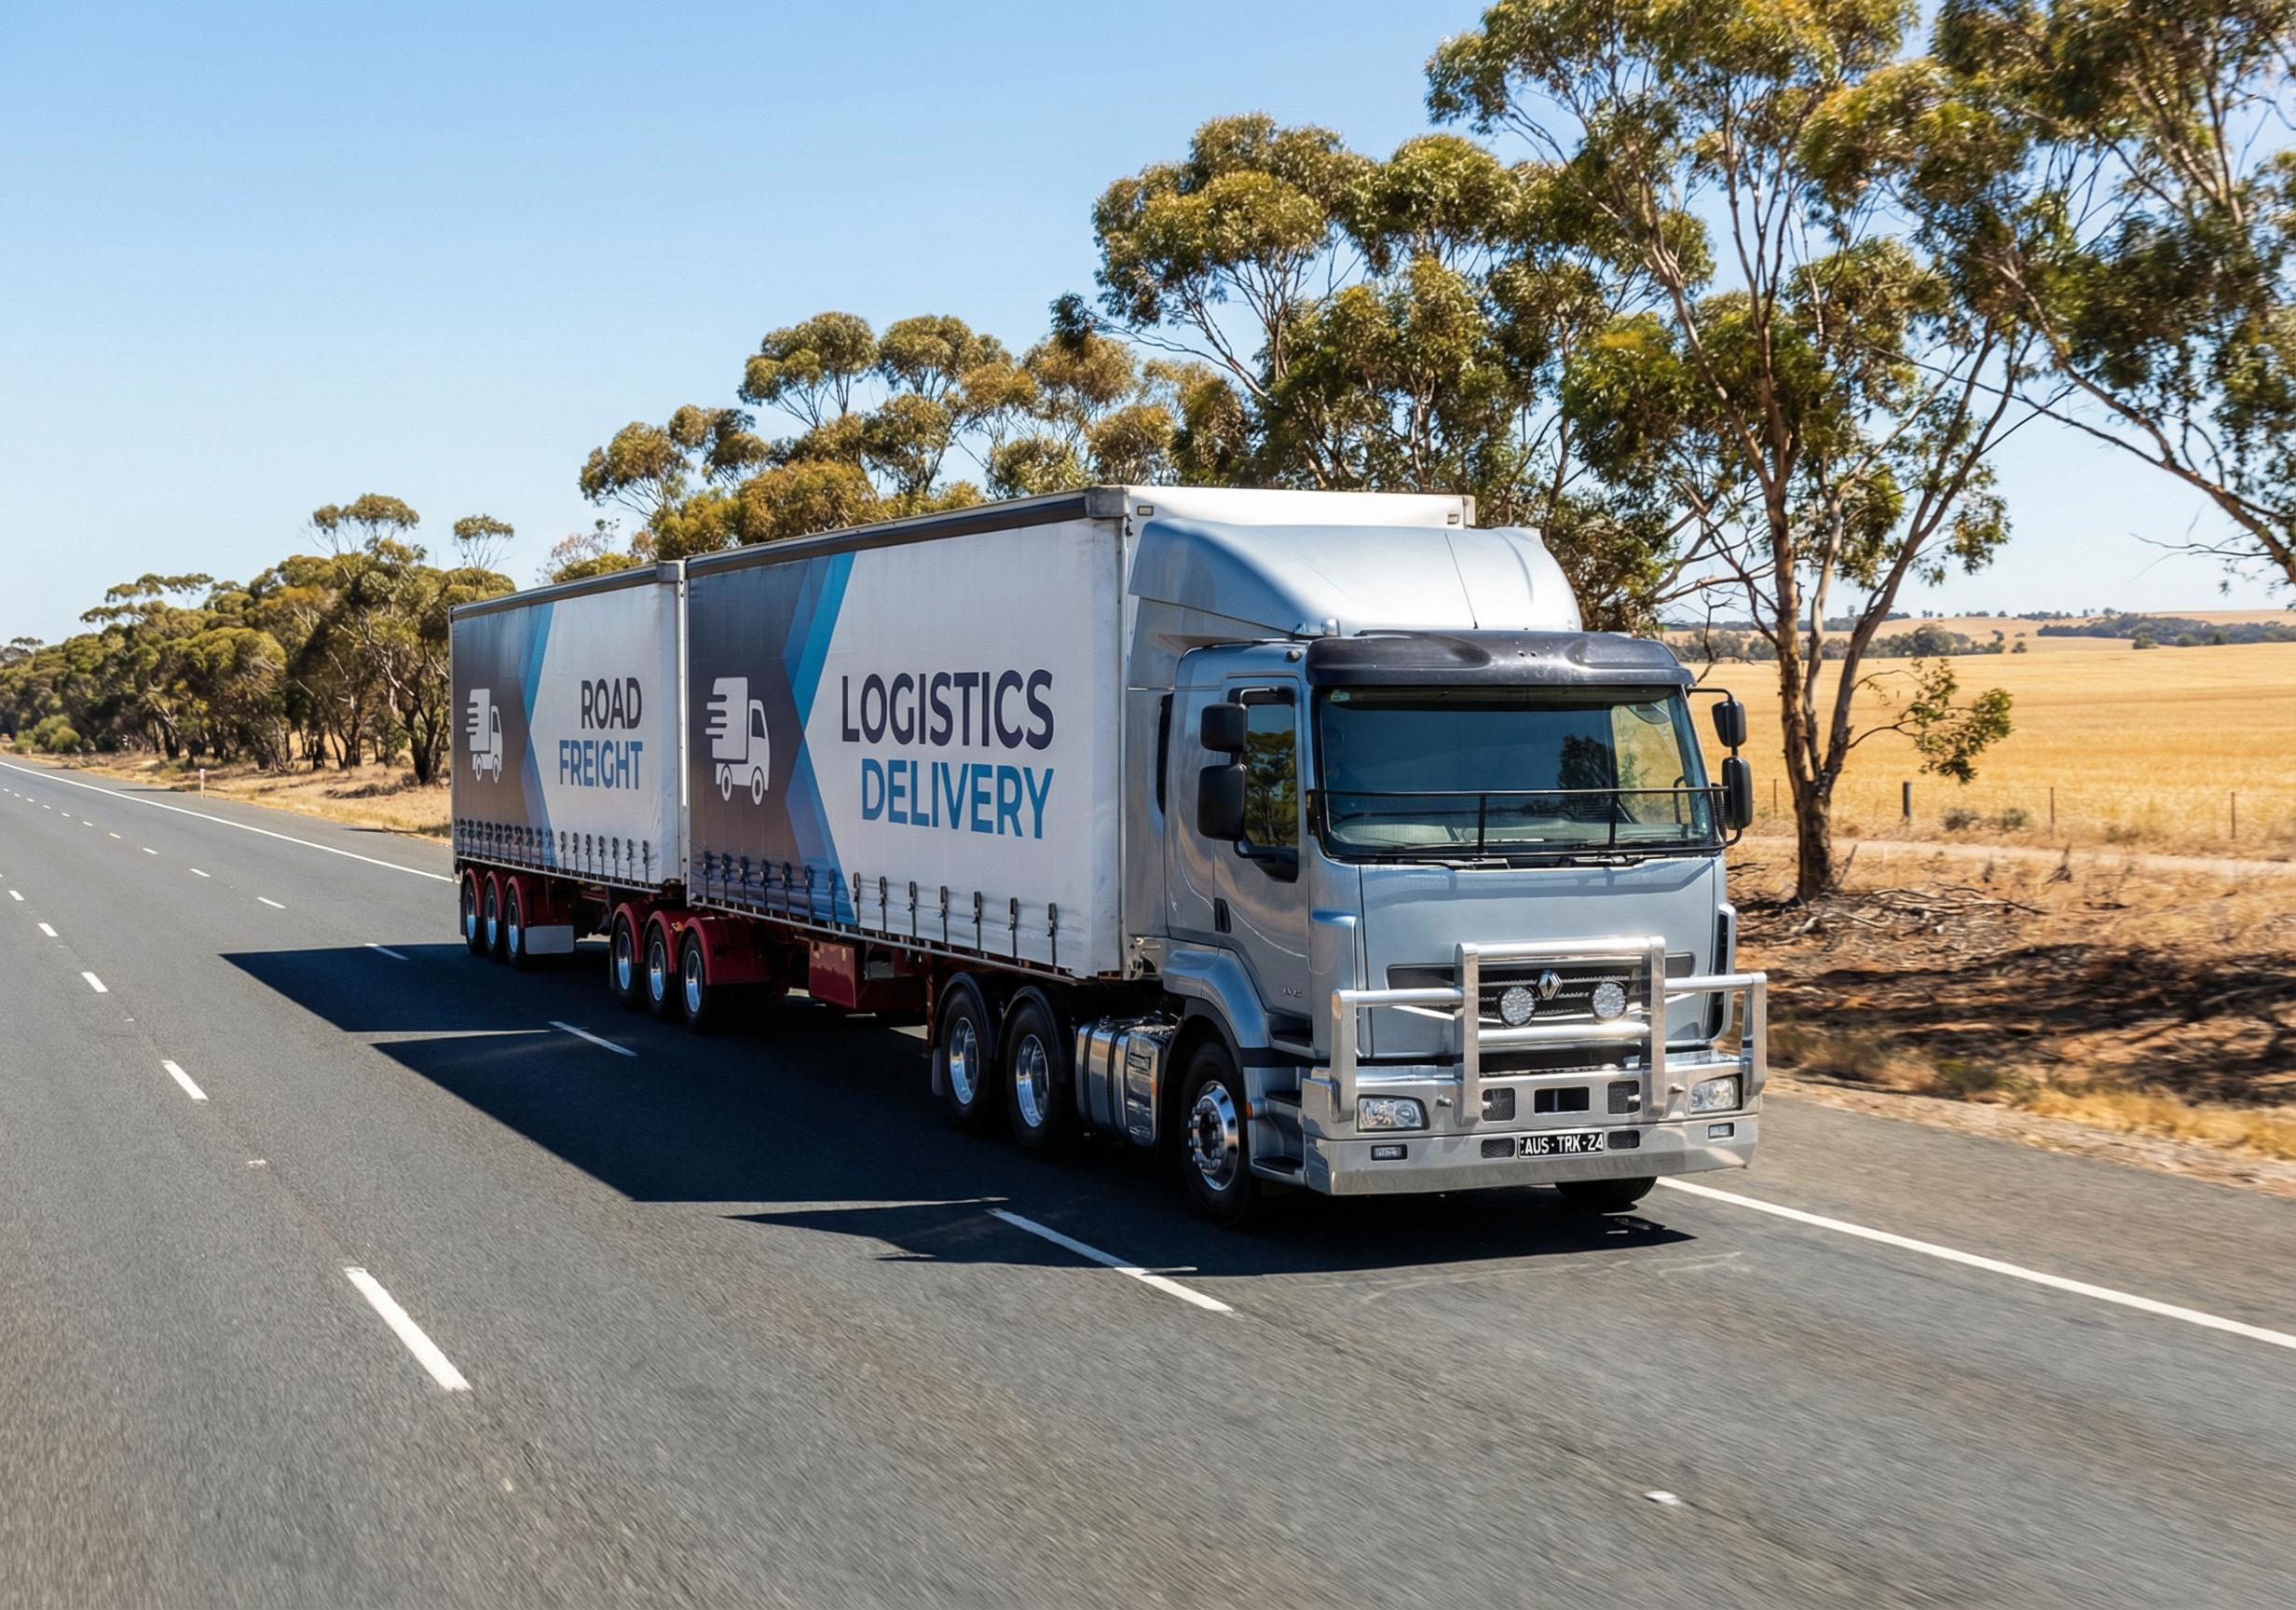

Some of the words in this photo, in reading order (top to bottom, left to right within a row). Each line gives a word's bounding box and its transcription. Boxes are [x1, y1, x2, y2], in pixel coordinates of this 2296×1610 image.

[581, 678, 643, 730] ROAD
[841, 669, 1054, 750] LOGISTICS
[560, 740, 643, 790] FREIGHT
[862, 758, 1054, 839] DELIVERY
